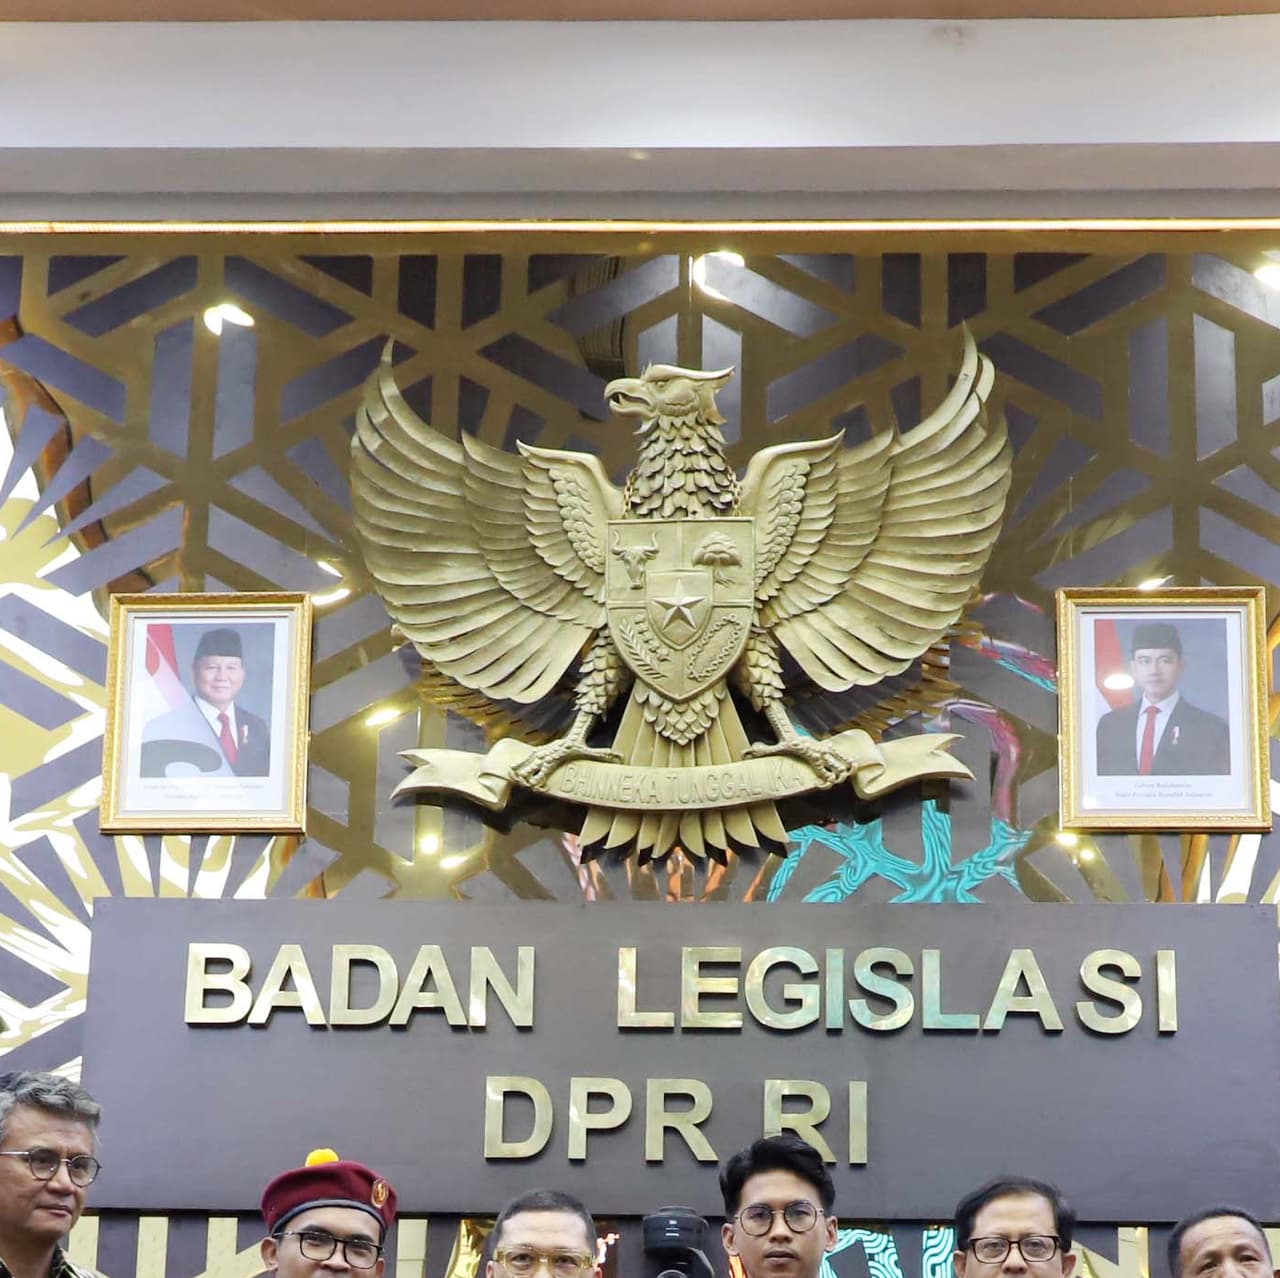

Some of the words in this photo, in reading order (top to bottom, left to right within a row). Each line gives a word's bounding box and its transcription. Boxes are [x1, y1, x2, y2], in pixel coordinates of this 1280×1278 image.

[560, 766, 661, 804] BHINNEKA
[665, 772, 762, 804] TUNGGAL
[184, 942, 535, 1028] BADAN
[617, 946, 1178, 1035] LEGISLASI
[484, 1076, 719, 1162] DPR
[763, 1078, 869, 1165] RI
